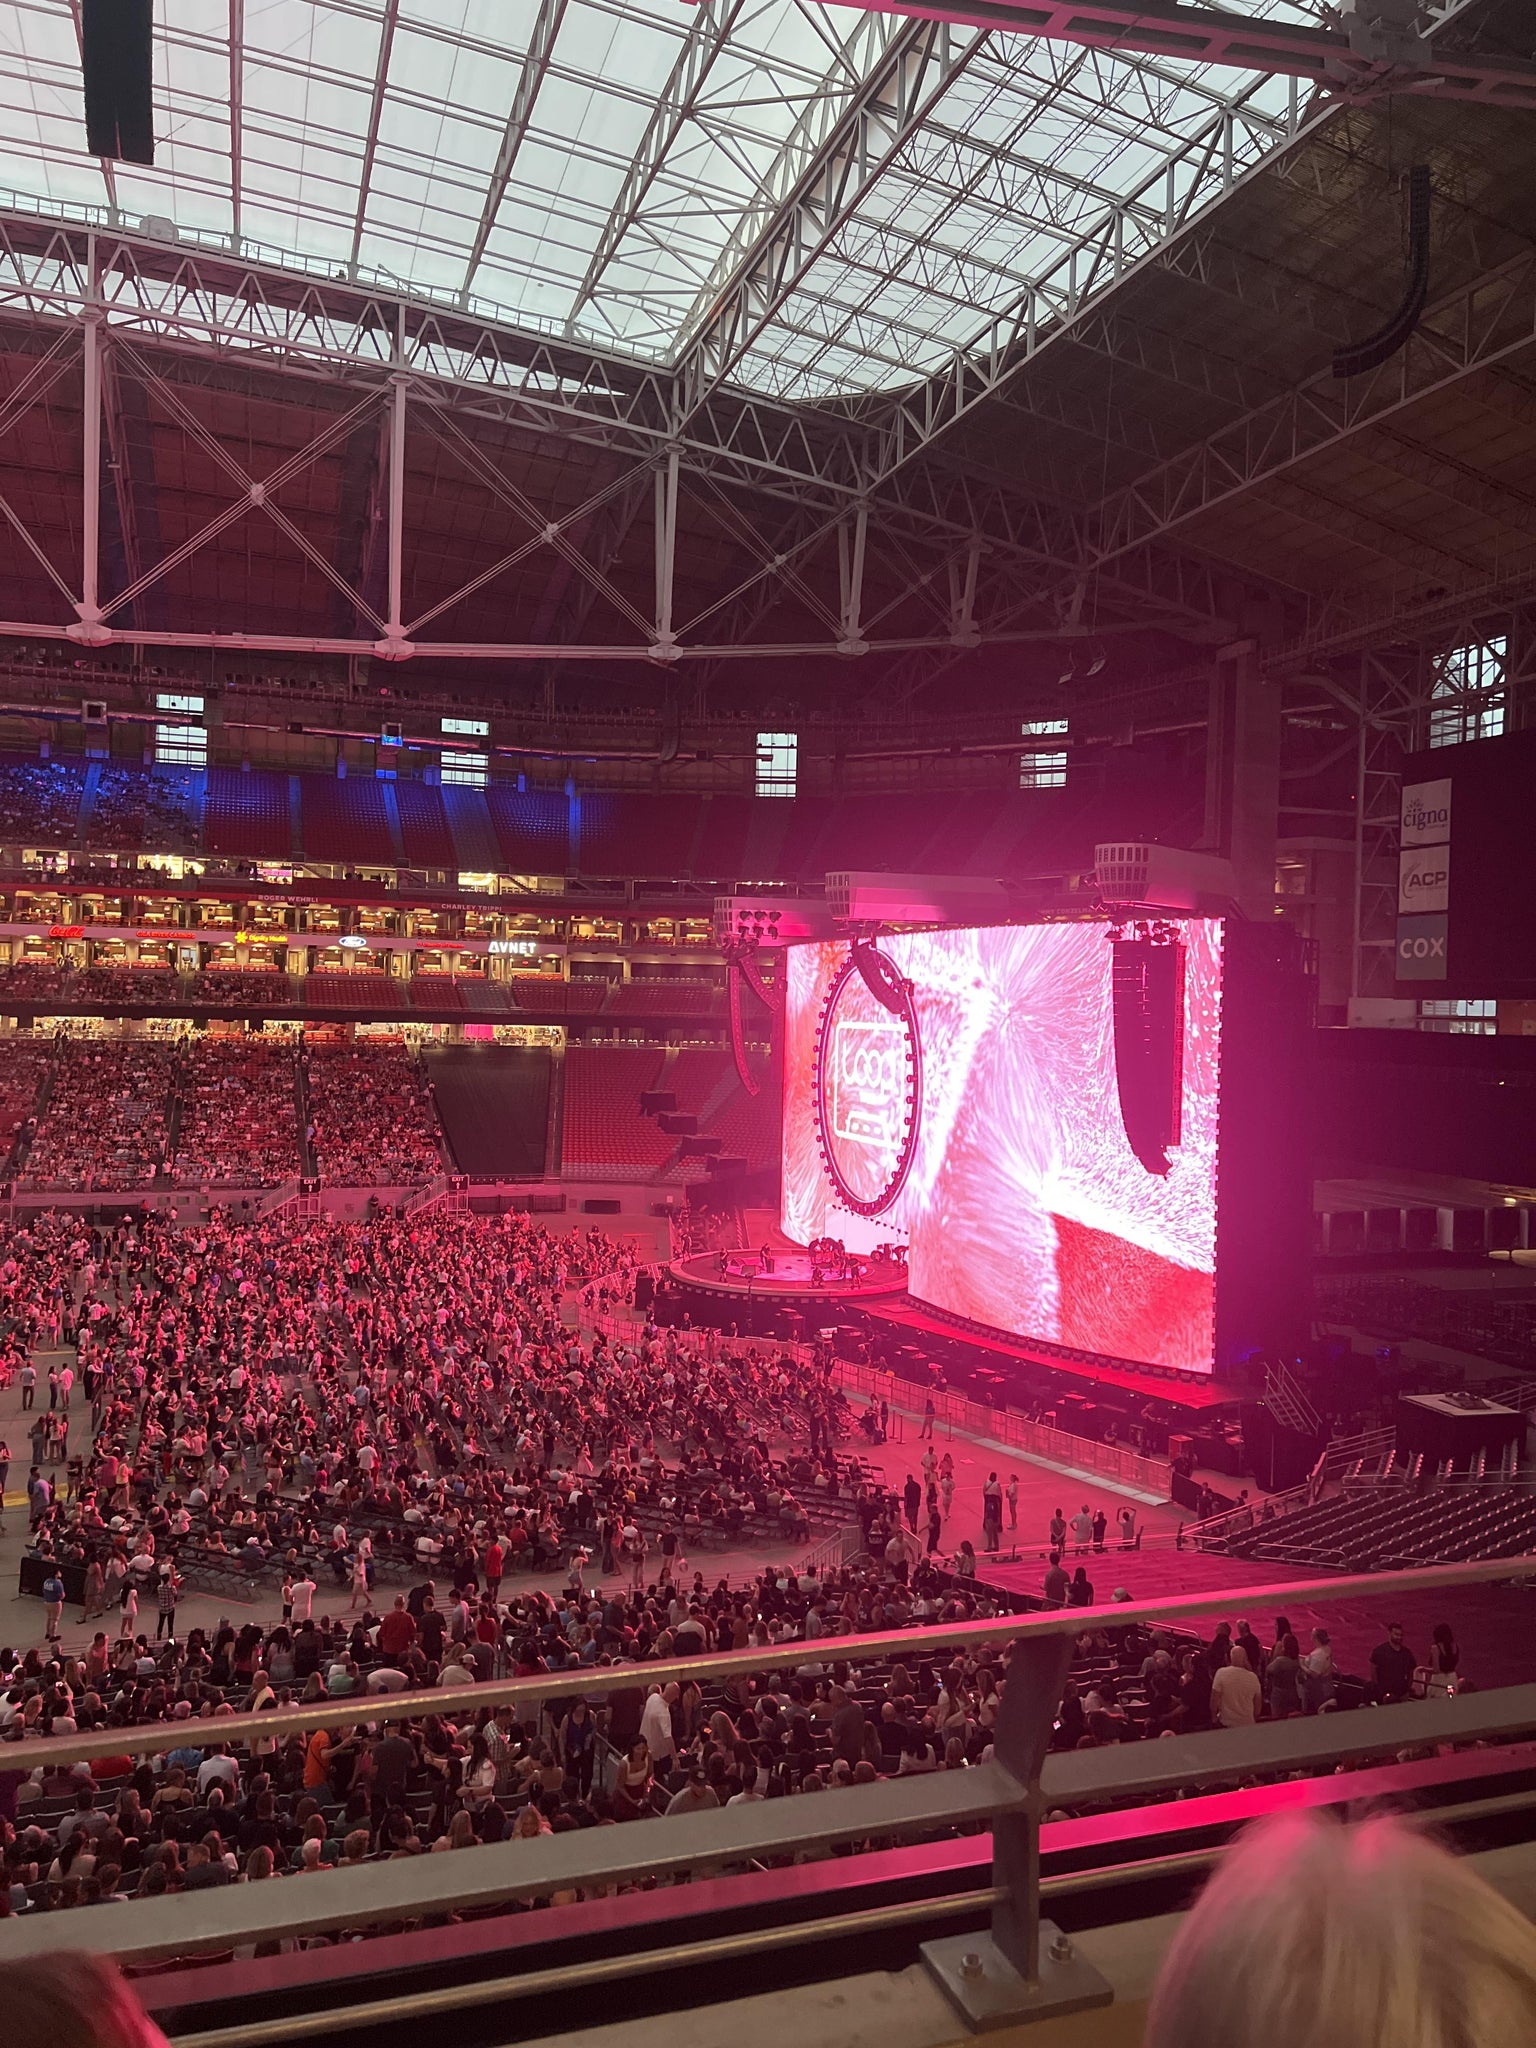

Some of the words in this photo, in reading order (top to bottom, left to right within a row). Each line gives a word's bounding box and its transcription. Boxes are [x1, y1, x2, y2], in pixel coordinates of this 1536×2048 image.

[1403, 808, 1448, 831] cigna
[1408, 871, 1447, 887] ACP
[488, 941, 537, 954] AVNET
[1399, 936, 1444, 959] COX
